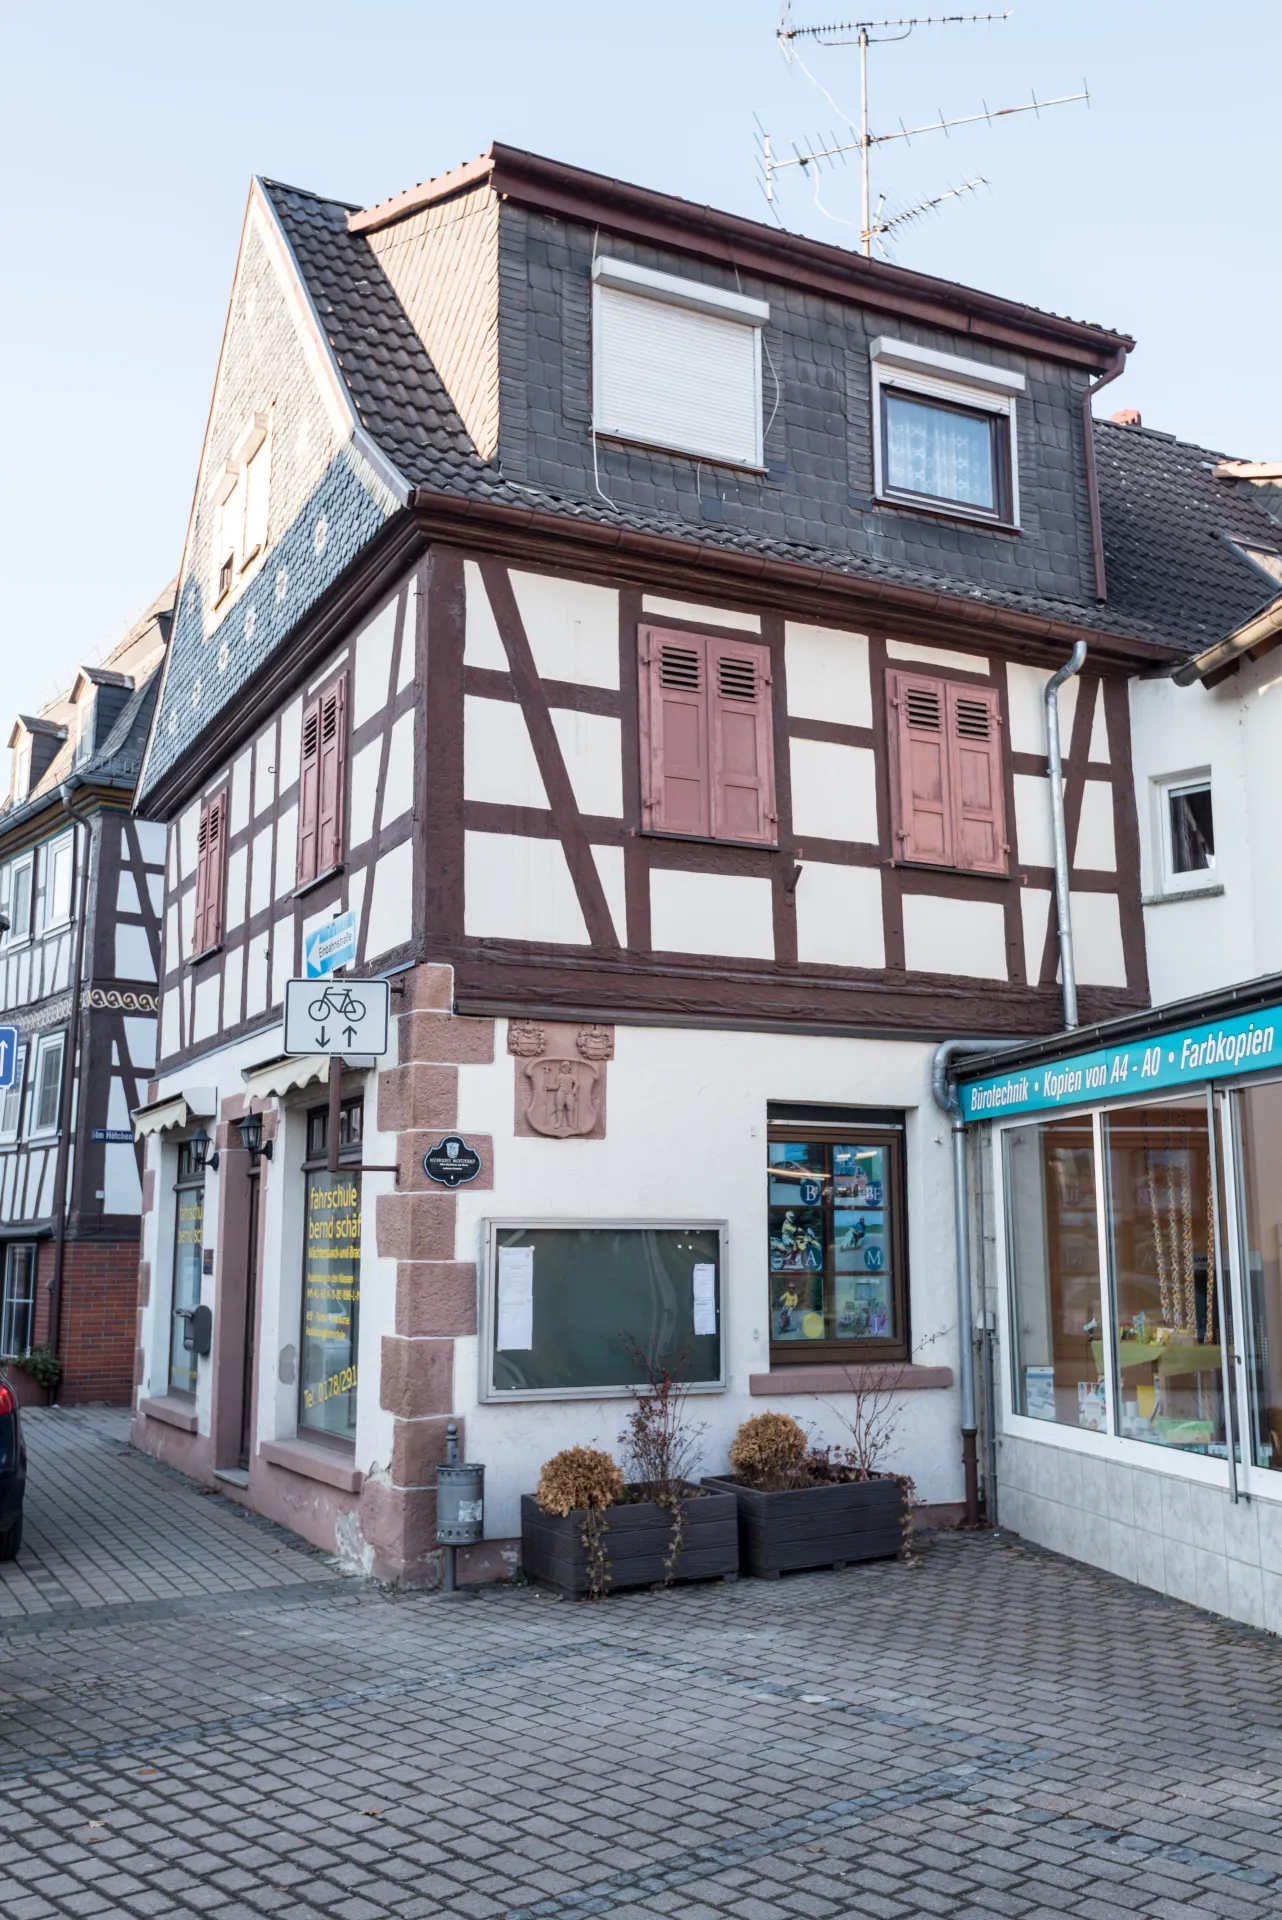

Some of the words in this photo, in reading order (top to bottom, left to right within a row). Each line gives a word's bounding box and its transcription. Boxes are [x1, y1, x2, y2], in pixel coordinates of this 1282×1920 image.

[319, 931, 352, 958] Einbahnstraße
[970, 1076, 1030, 1111] Bürotechnik
[1043, 1066, 1082, 1101] Kopien
[1085, 1064, 1107, 1089] von
[1110, 1053, 1129, 1084] A4
[1141, 1046, 1161, 1078] A0
[1180, 1023, 1275, 1070] Farbkopien
[310, 1183, 358, 1210] fahrschule
[805, 1184, 817, 1201] B
[309, 1215, 335, 1239] bernd
[805, 1249, 818, 1266] A
[867, 1250, 882, 1265] M
[304, 1389, 316, 1409] Tel.
